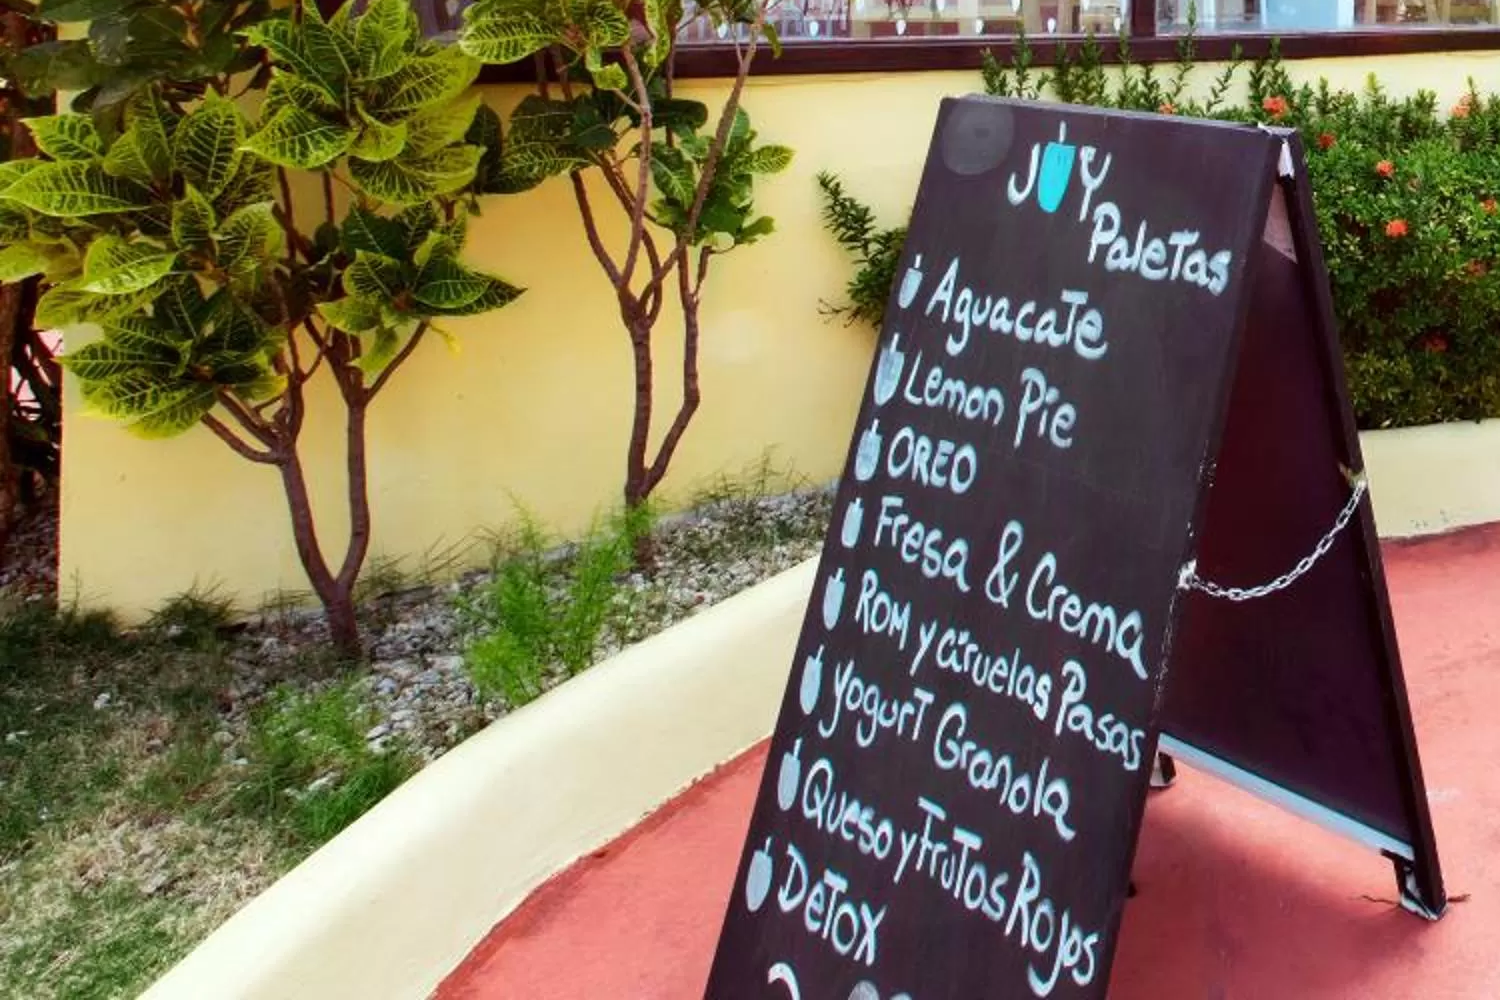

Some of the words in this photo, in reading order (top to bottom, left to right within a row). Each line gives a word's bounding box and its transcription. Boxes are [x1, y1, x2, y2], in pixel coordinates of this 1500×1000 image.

[904, 348, 1004, 424] Lemon
[1014, 367, 1077, 449] Pie
[887, 427, 977, 492] OREO
[874, 496, 971, 593] Fresa
[984, 519, 1023, 607] &
[1025, 553, 1148, 680] Crema
[1055, 661, 1145, 771] Pasas
[801, 759, 893, 860] Queso
[933, 703, 1077, 842] Granola
